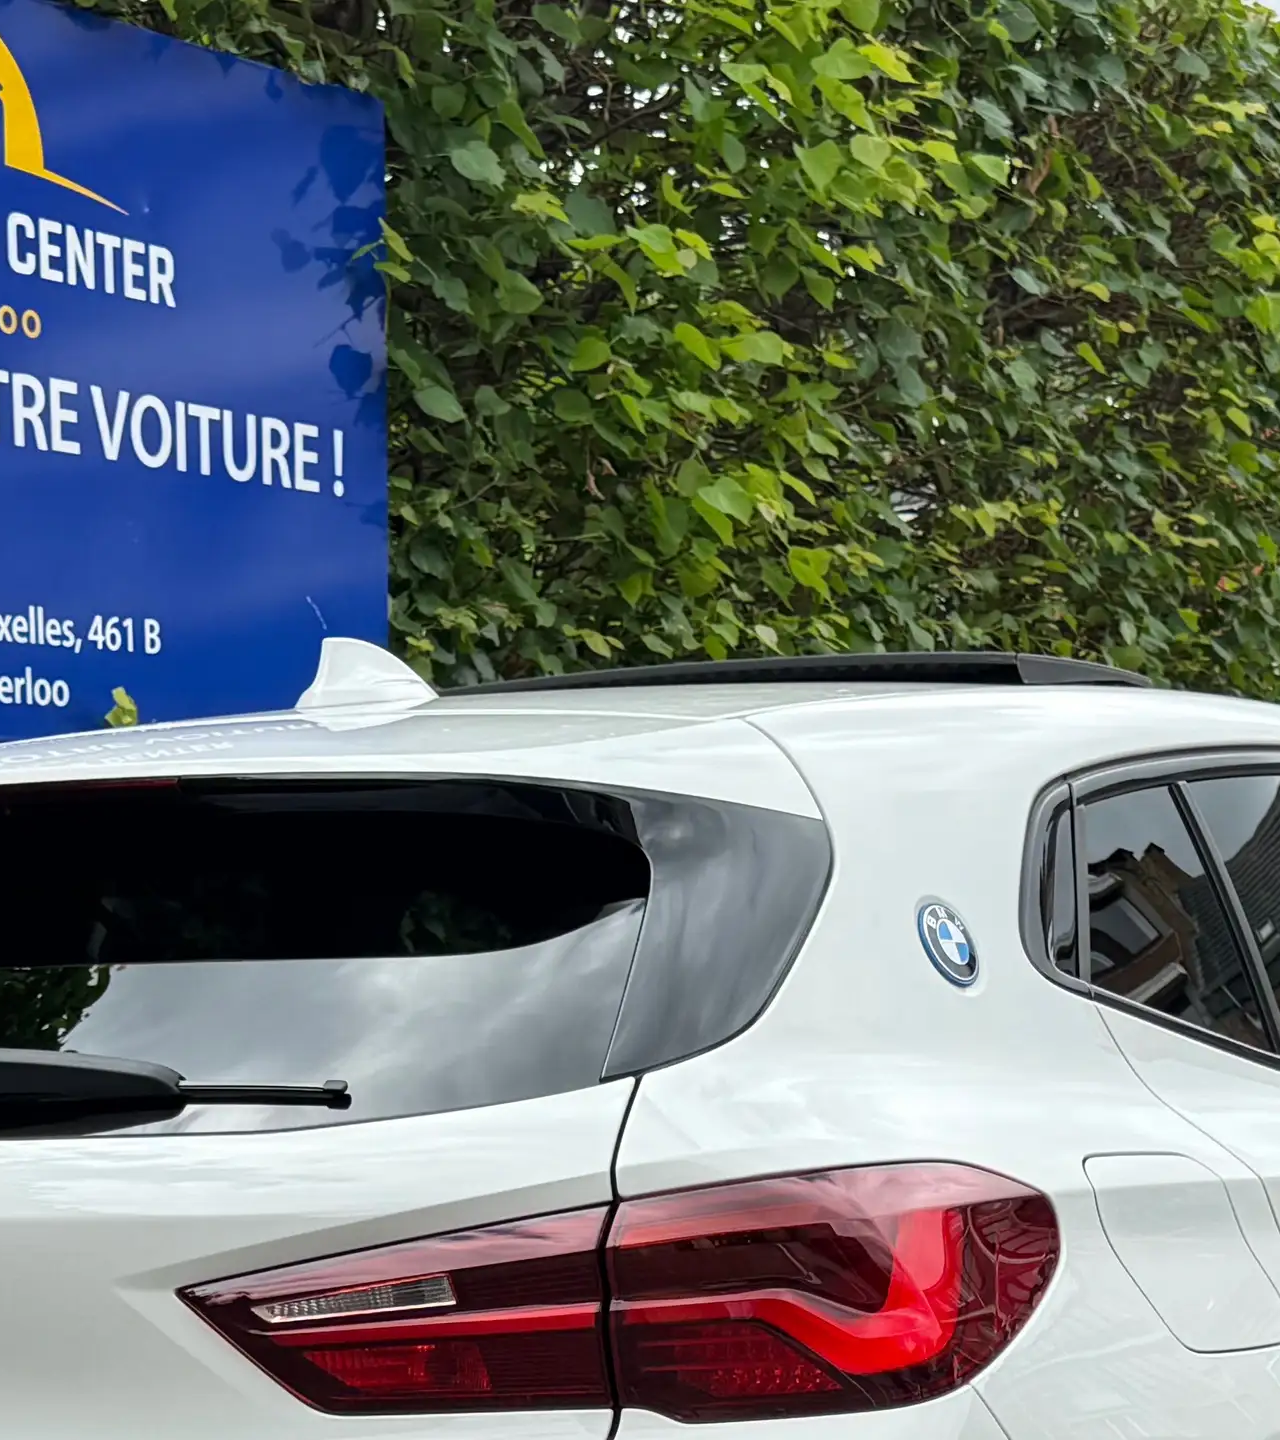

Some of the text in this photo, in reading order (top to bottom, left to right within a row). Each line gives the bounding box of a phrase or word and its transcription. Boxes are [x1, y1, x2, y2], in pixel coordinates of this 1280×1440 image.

[7, 212, 176, 308] CENTER
[89, 384, 320, 493] VOITURE
[332, 429, 345, 497] !
[87, 615, 134, 653] 461
[145, 618, 161, 654] B
[926, 906, 965, 931] BMW
